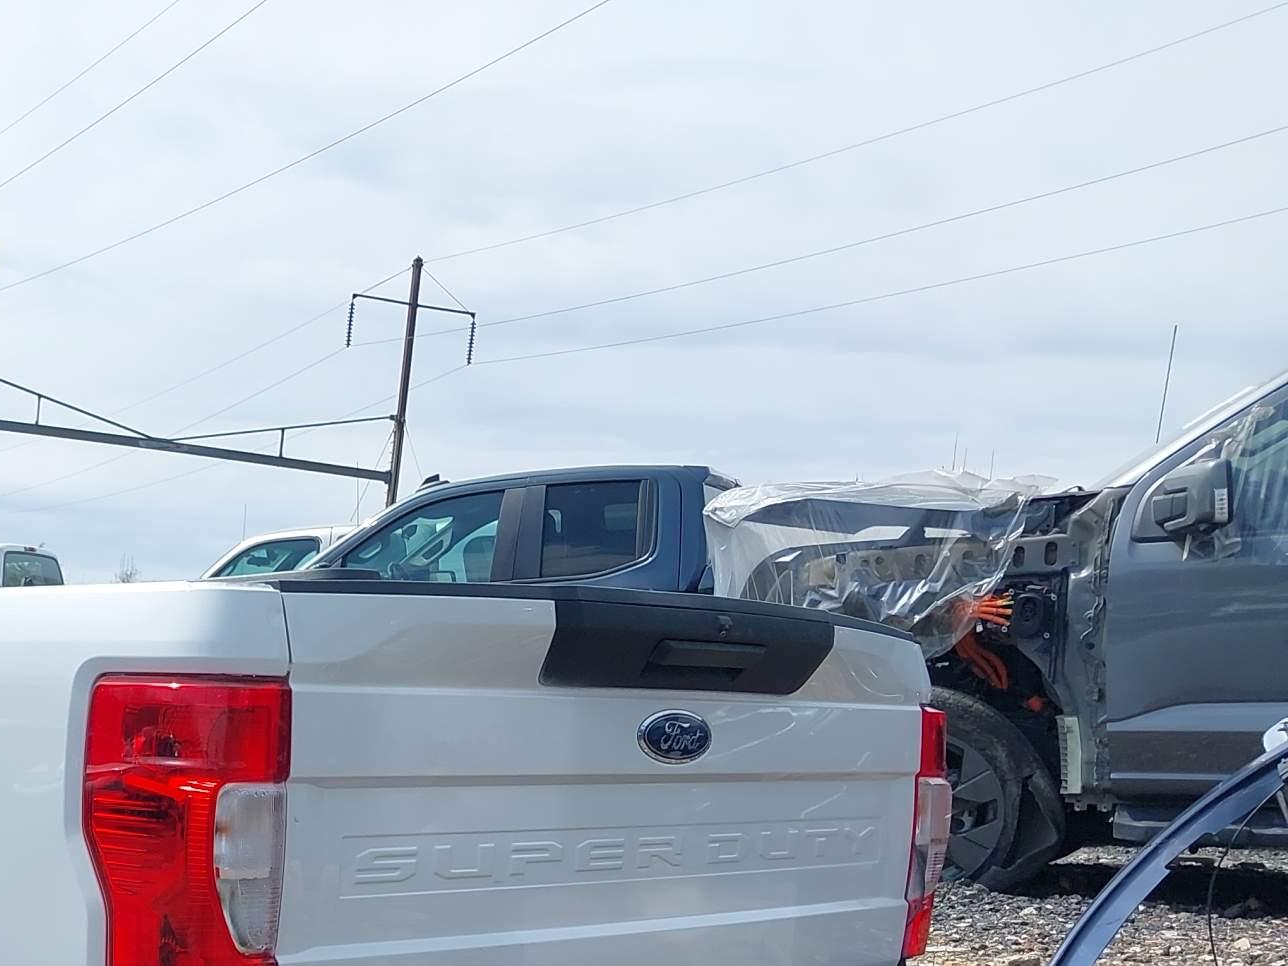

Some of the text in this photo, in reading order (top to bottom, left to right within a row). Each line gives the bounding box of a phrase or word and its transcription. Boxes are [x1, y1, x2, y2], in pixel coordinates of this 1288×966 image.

[660, 720, 704, 750] Ford
[354, 825, 875, 885] SUPER DUTY
